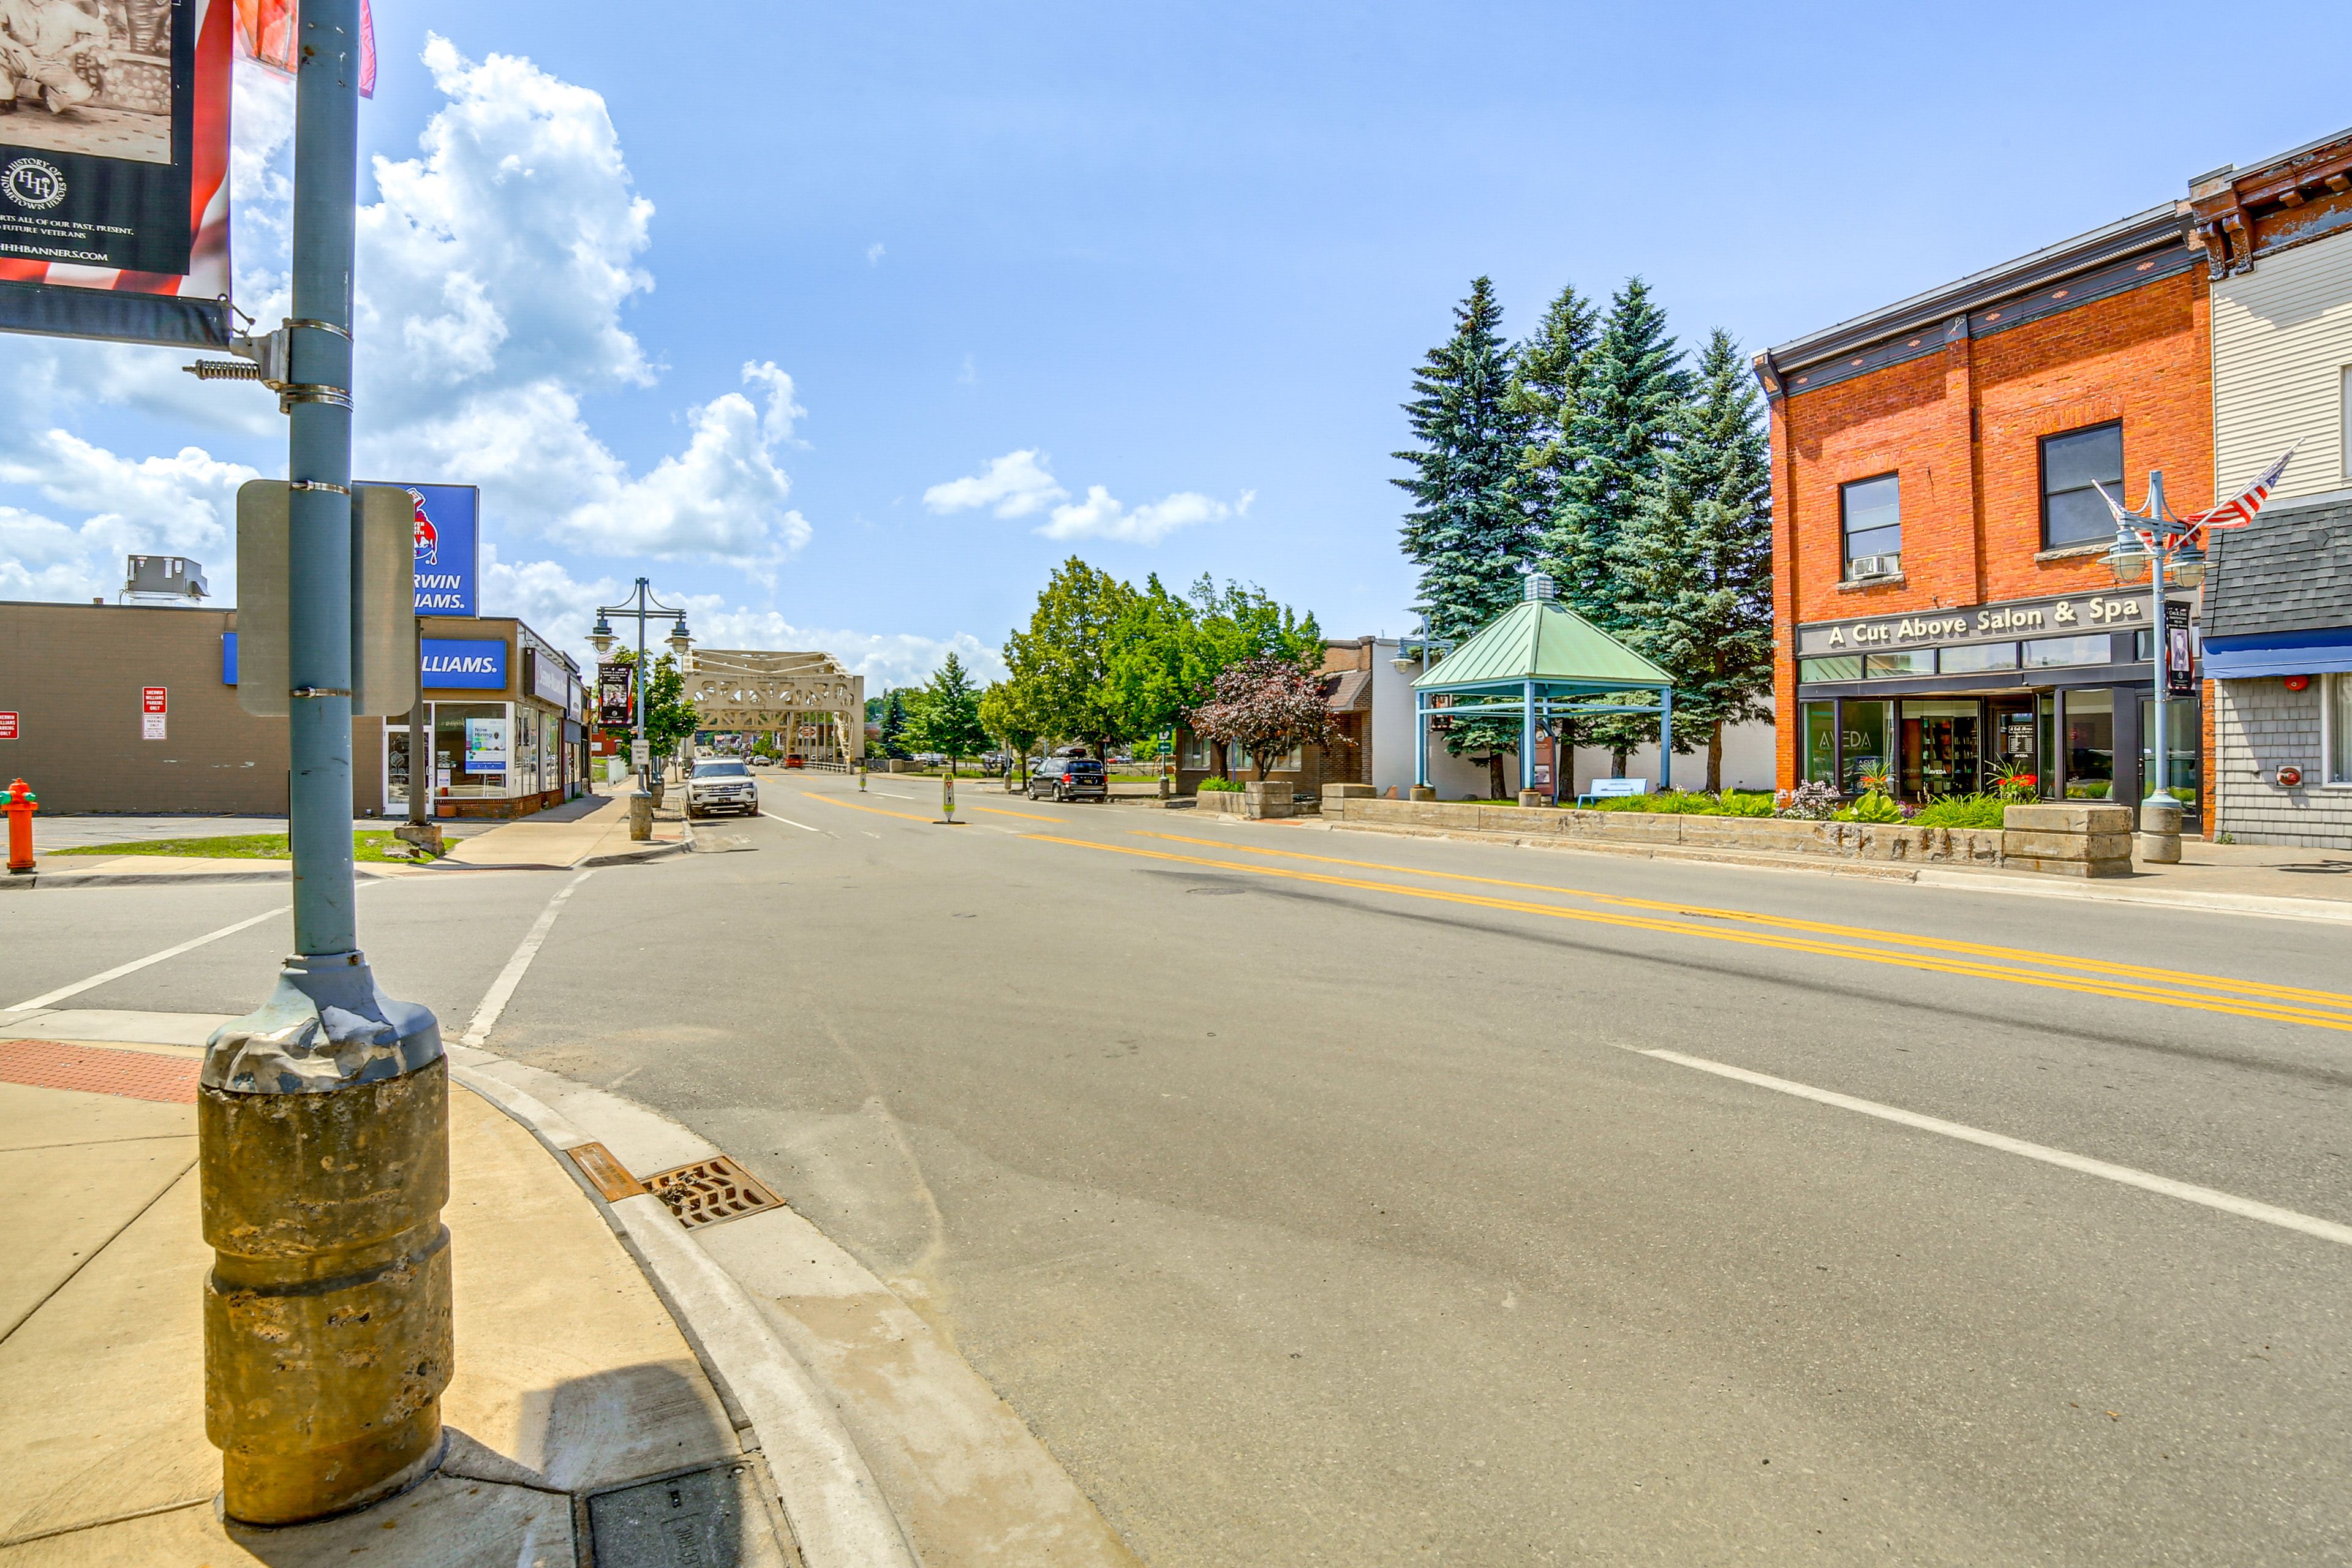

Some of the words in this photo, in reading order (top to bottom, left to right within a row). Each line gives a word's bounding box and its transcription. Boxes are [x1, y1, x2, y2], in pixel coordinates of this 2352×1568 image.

[7, 157, 50, 171] HISTORY
[49, 167, 62, 176] OF
[1, 176, 46, 210] HOMETOWN
[46, 183, 67, 208] HEROES
[3, 224, 38, 234] FUTURE
[40, 228, 86, 239] VETERANS
[413, 573, 461, 589] RWIN
[414, 594, 466, 609] IAMS.
[1828, 626, 1845, 644] A
[1852, 624, 1889, 642] Cut
[1897, 617, 1968, 638] Above
[1977, 608, 2042, 630] Salon
[2054, 601, 2076, 622] &
[2089, 597, 2139, 624] Spa
[421, 656, 497, 673] LLIAMS.
